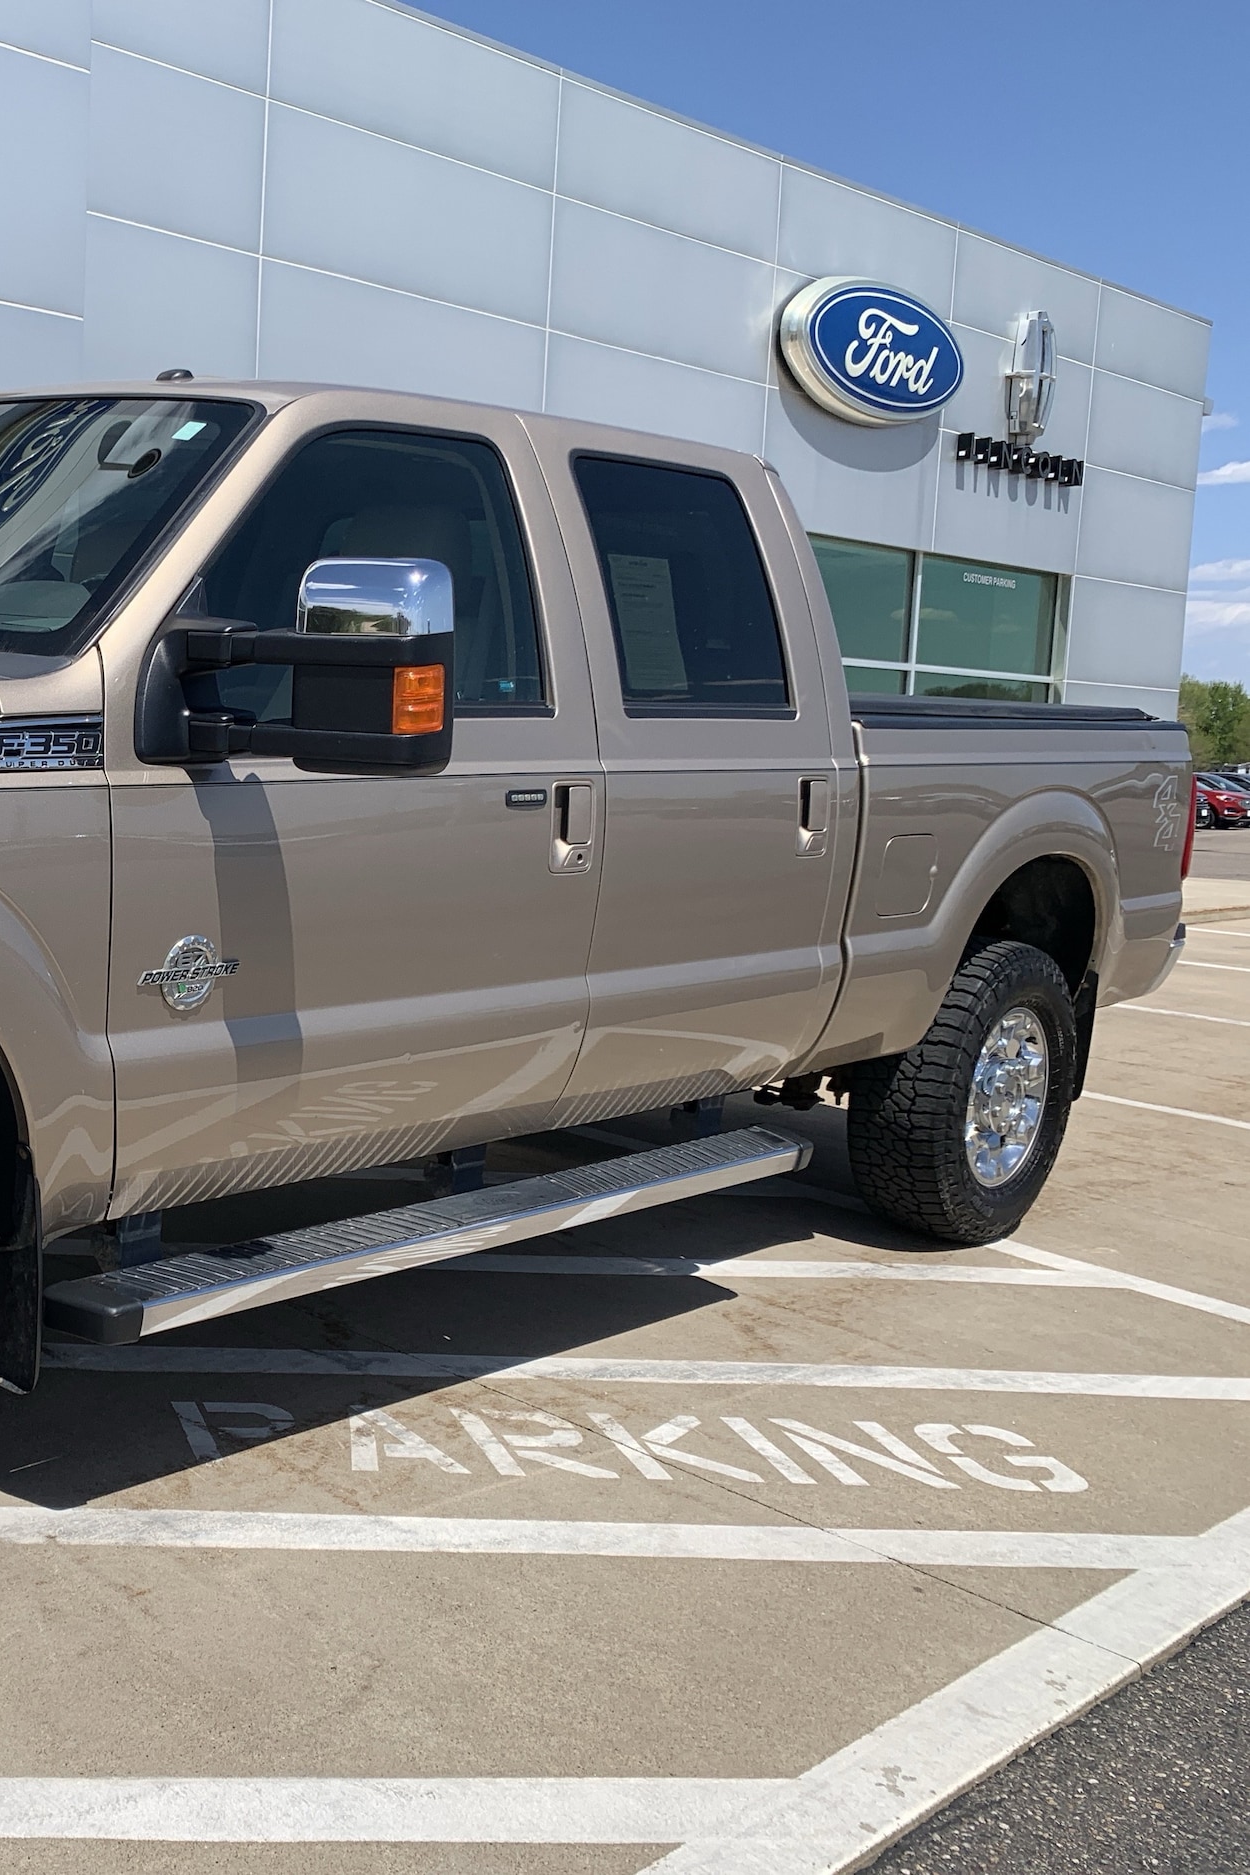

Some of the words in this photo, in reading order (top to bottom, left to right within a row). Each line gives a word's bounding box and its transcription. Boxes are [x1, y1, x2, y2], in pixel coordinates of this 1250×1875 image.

[845, 308, 939, 395] Ford
[957, 432, 1085, 486] LINCOLN
[963, 572, 993, 586] CUSTOMER
[993, 576, 1017, 589] PARKING
[57, 758, 100, 768] DUTY
[169, 1400, 1090, 1494] PARKING
